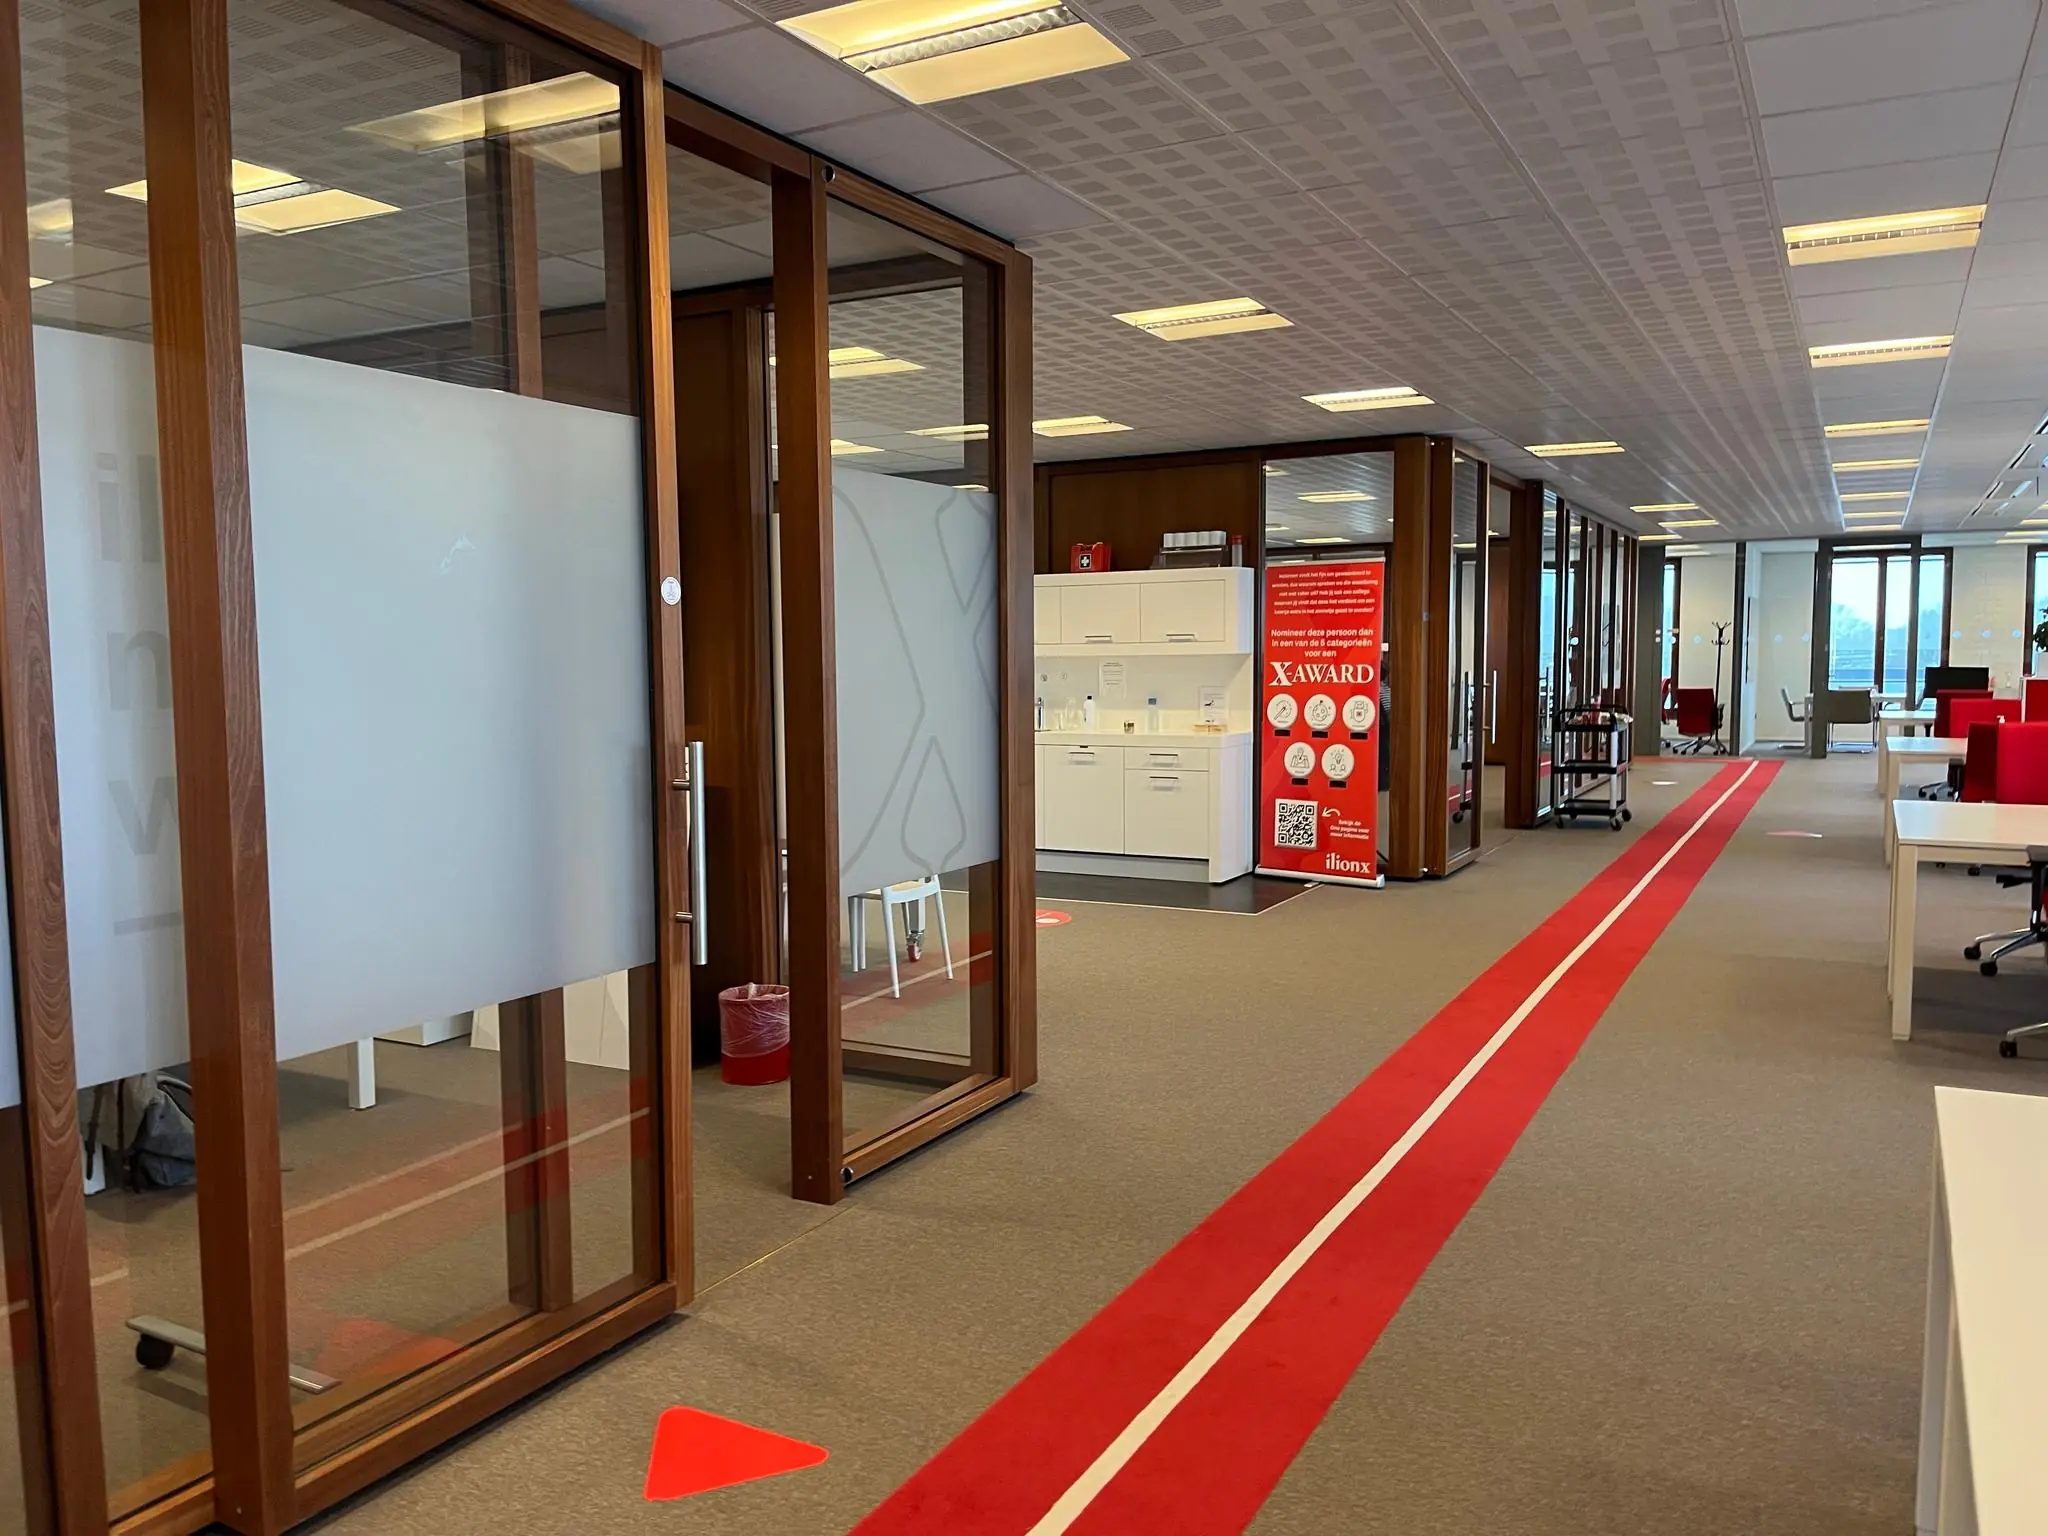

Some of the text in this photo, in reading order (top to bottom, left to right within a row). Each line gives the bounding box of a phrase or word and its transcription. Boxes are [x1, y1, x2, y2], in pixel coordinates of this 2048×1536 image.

[1271, 628, 1373, 638] Nomineer deze persoon dan
[1272, 639, 1279, 647] in
[1310, 639, 1318, 647] de
[1269, 661, 1374, 686] X-AWARD
[1326, 853, 1370, 873] ilionx
